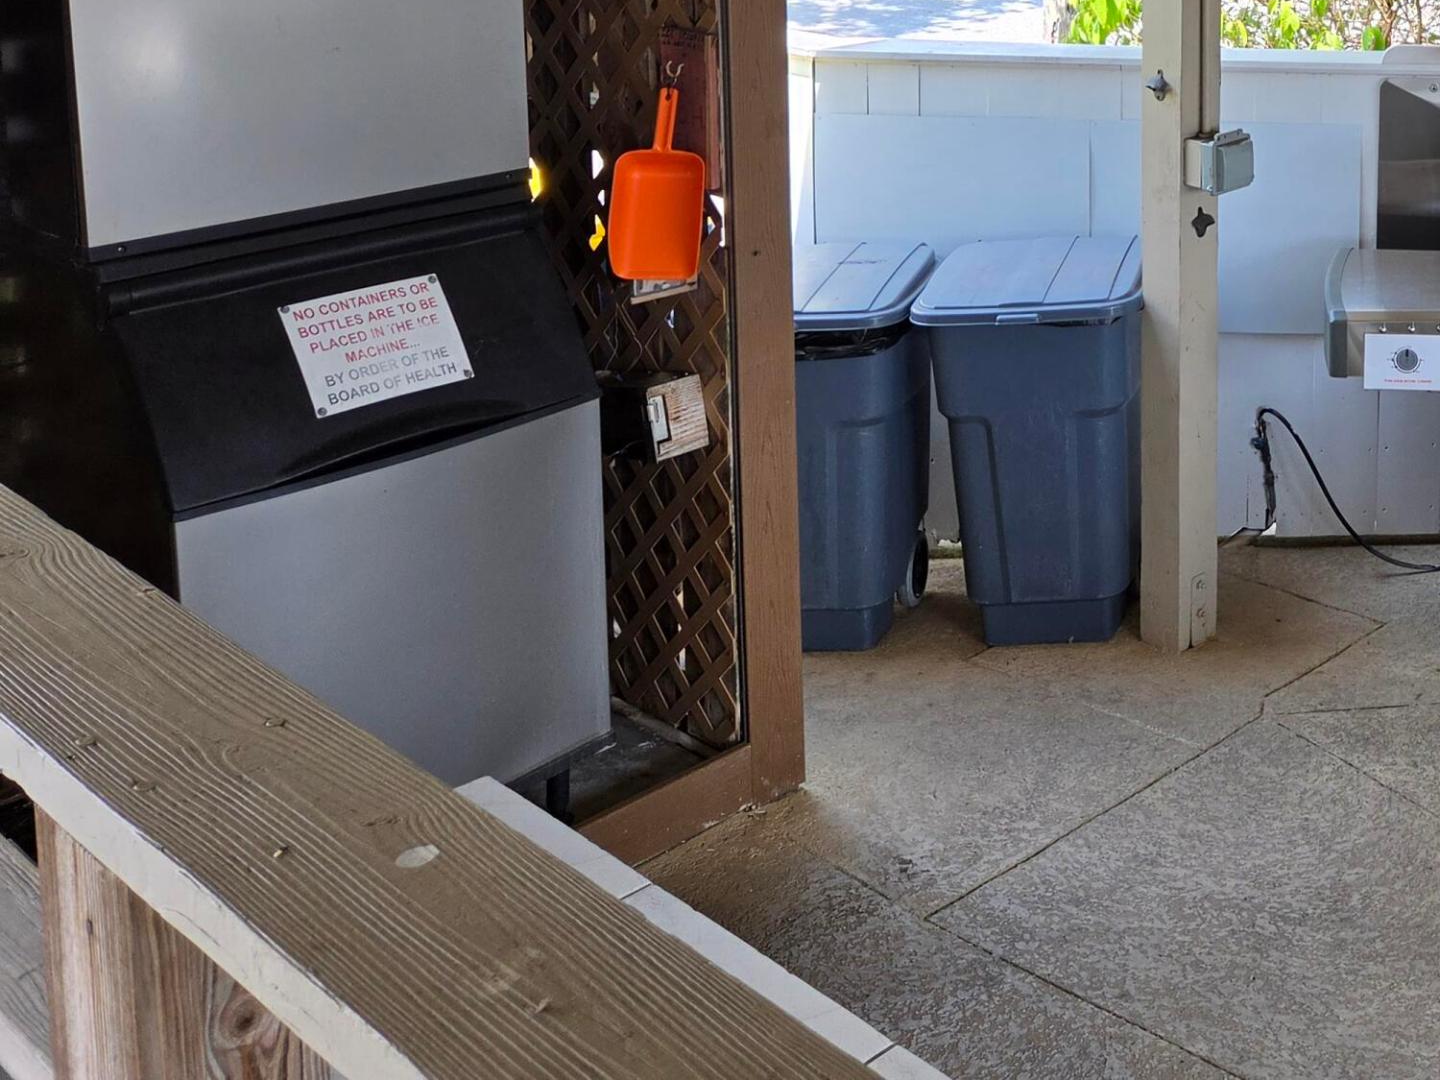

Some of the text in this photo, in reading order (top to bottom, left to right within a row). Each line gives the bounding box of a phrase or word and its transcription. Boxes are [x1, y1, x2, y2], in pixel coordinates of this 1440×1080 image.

[293, 282, 430, 322] NO CONTAINERS OR
[298, 297, 438, 339] BOTTLES ARE TO BE
[309, 331, 368, 354] PLACED
[370, 327, 385, 338] IN
[387, 319, 414, 335] THE
[324, 346, 450, 388] BY ORDER OF THE
[328, 362, 457, 406] BOARD OF HEALTH
